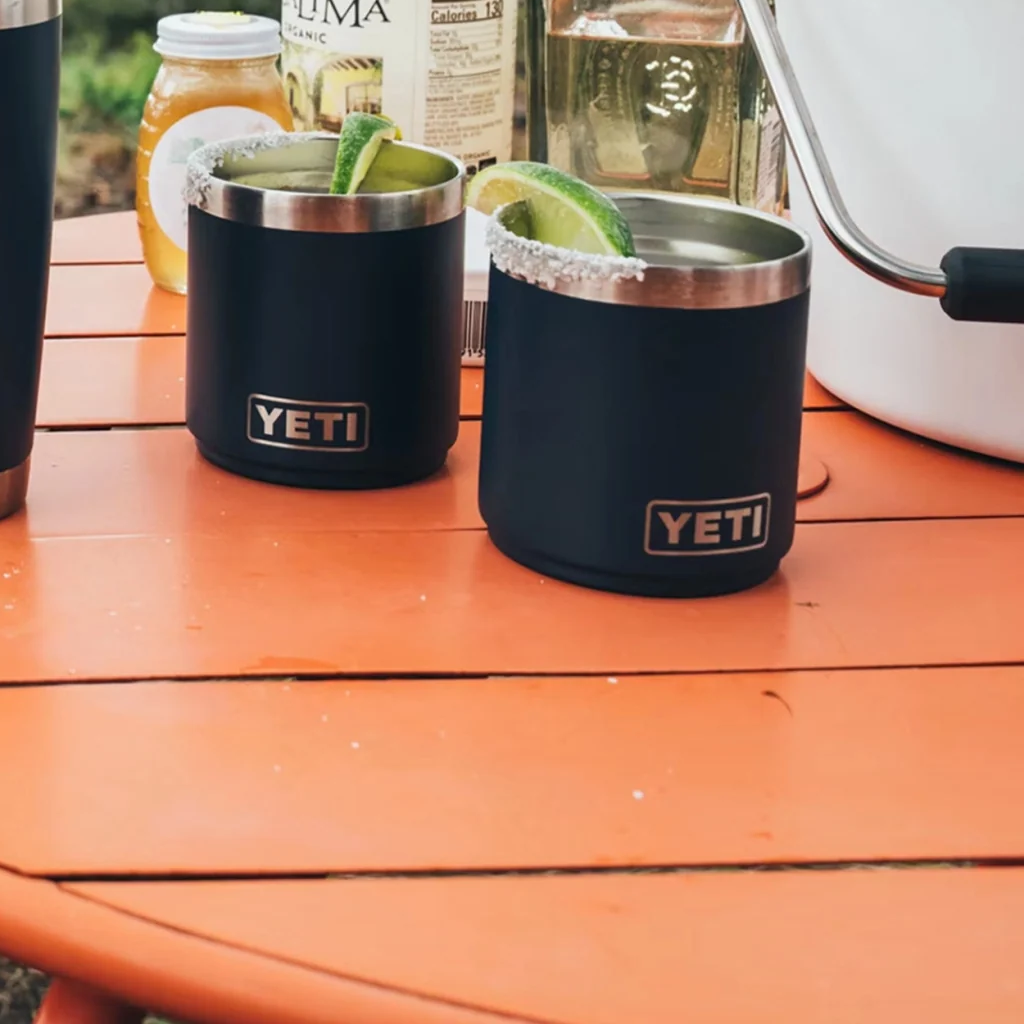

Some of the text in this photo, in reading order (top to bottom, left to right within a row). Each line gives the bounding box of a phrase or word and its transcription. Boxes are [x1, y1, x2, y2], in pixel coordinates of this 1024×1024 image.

[431, 9, 478, 23] Calories
[485, 0, 504, 19] 130
[255, 403, 358, 442] YETI
[657, 504, 763, 545] YETI
